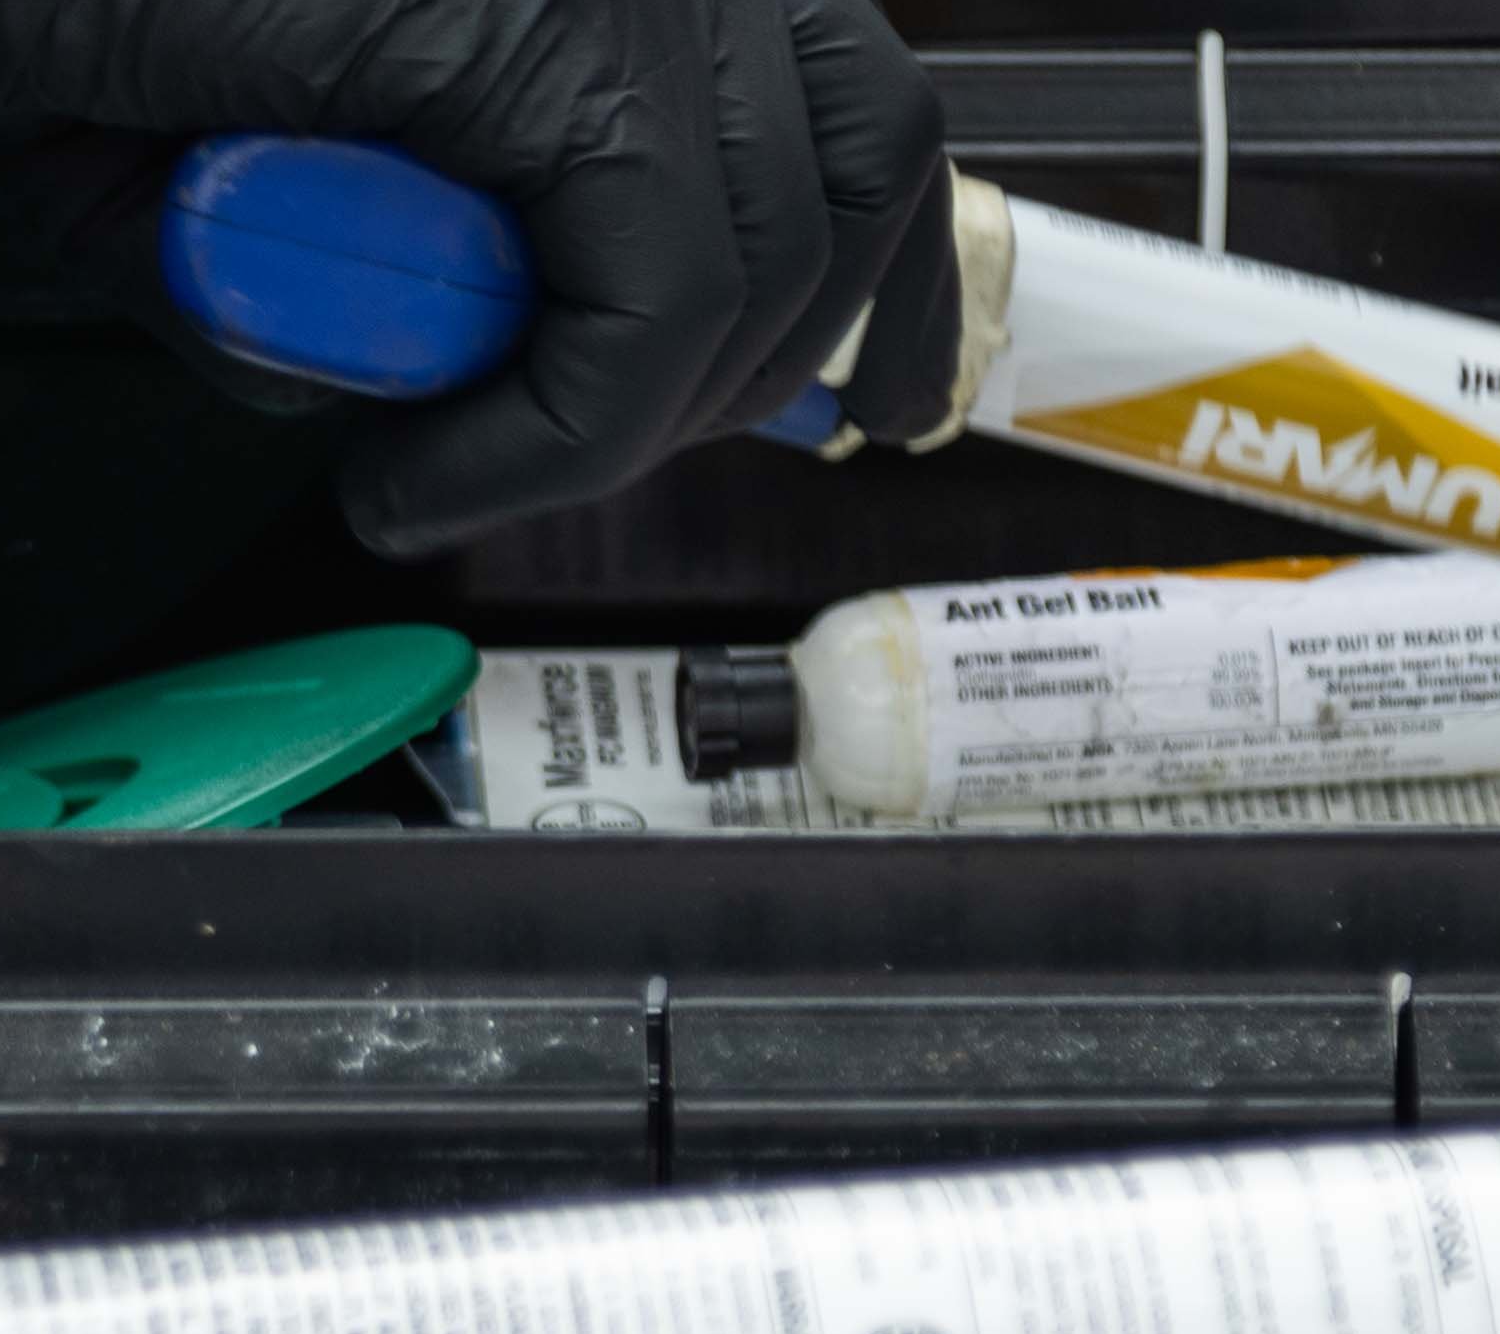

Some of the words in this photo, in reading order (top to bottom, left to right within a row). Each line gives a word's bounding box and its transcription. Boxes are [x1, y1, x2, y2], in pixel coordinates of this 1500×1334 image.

[945, 595, 1007, 623] Ant
[1017, 592, 1076, 618] Gel
[1090, 586, 1162, 611] Bait
[1289, 637, 1331, 656] KEEP
[1337, 635, 1369, 653] OUT
[1377, 633, 1398, 650] OF
[1404, 630, 1460, 647] REACH
[1465, 626, 1486, 643] OF
[953, 651, 1006, 668] ACTIVE
[958, 685, 1009, 702] OTHER
